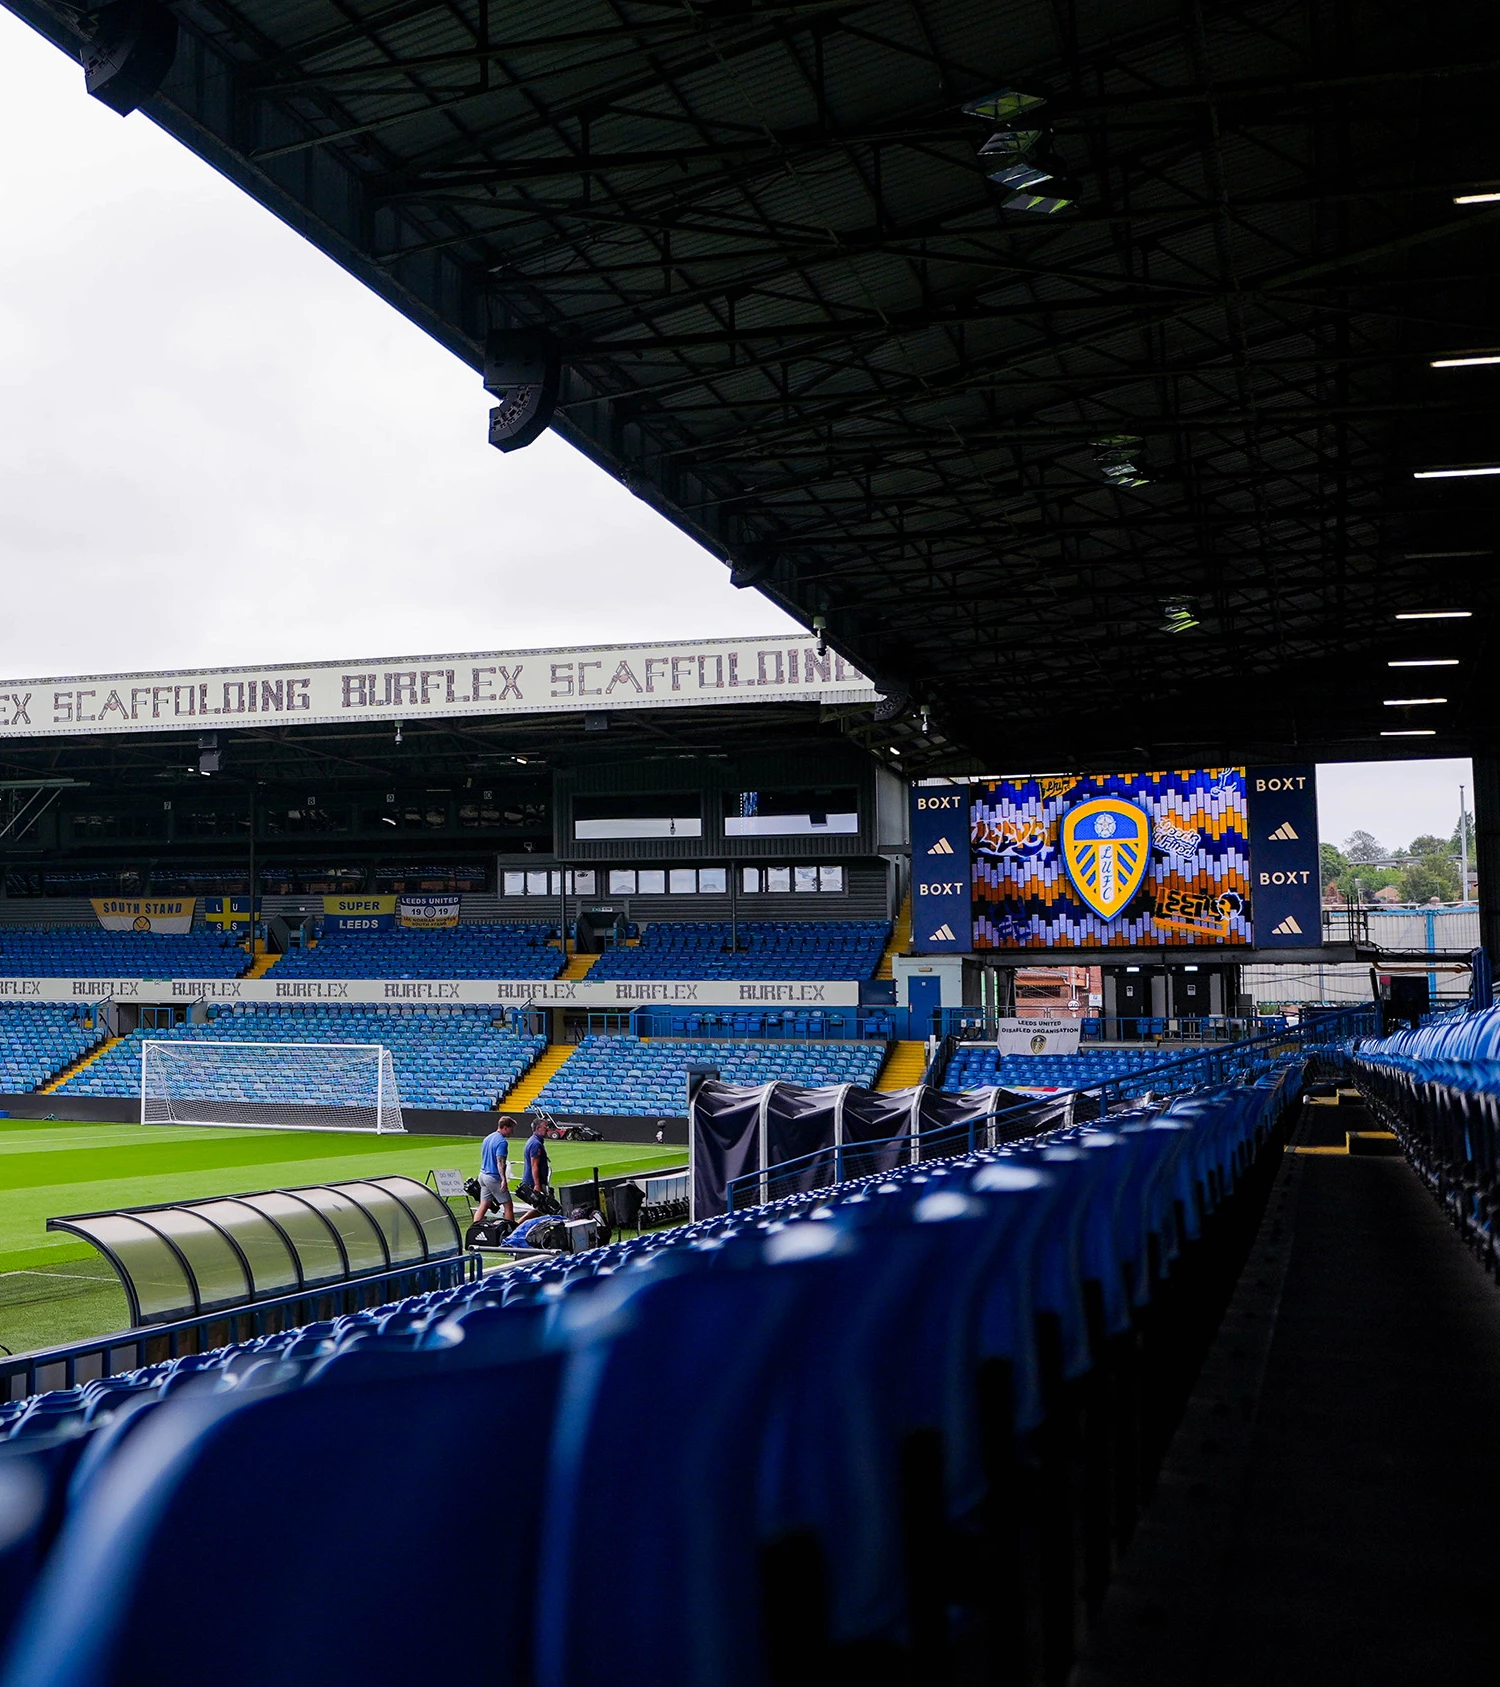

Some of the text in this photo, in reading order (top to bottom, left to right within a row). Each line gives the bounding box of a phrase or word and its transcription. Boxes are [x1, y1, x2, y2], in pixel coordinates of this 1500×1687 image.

[341, 664, 523, 708] BURFLEX
[53, 678, 311, 721] SCAFFOLDING
[1256, 776, 1307, 792] BOXT
[917, 796, 961, 810] BOXT
[1260, 871, 1310, 886] BOXT
[919, 882, 963, 896] BOXT
[103, 901, 182, 914] SOUTH STAND
[339, 901, 380, 911] SUPER
[339, 919, 379, 929] LEEDS
[72, 981, 138, 995] BURFLEX
[172, 981, 242, 996] BURFLEX
[276, 982, 348, 997] BURFLEX
[384, 983, 459, 998] BURFLEX
[498, 983, 576, 999] BURFLEX
[616, 984, 698, 999] BURFLEX
[739, 984, 825, 1000] BURFLEX
